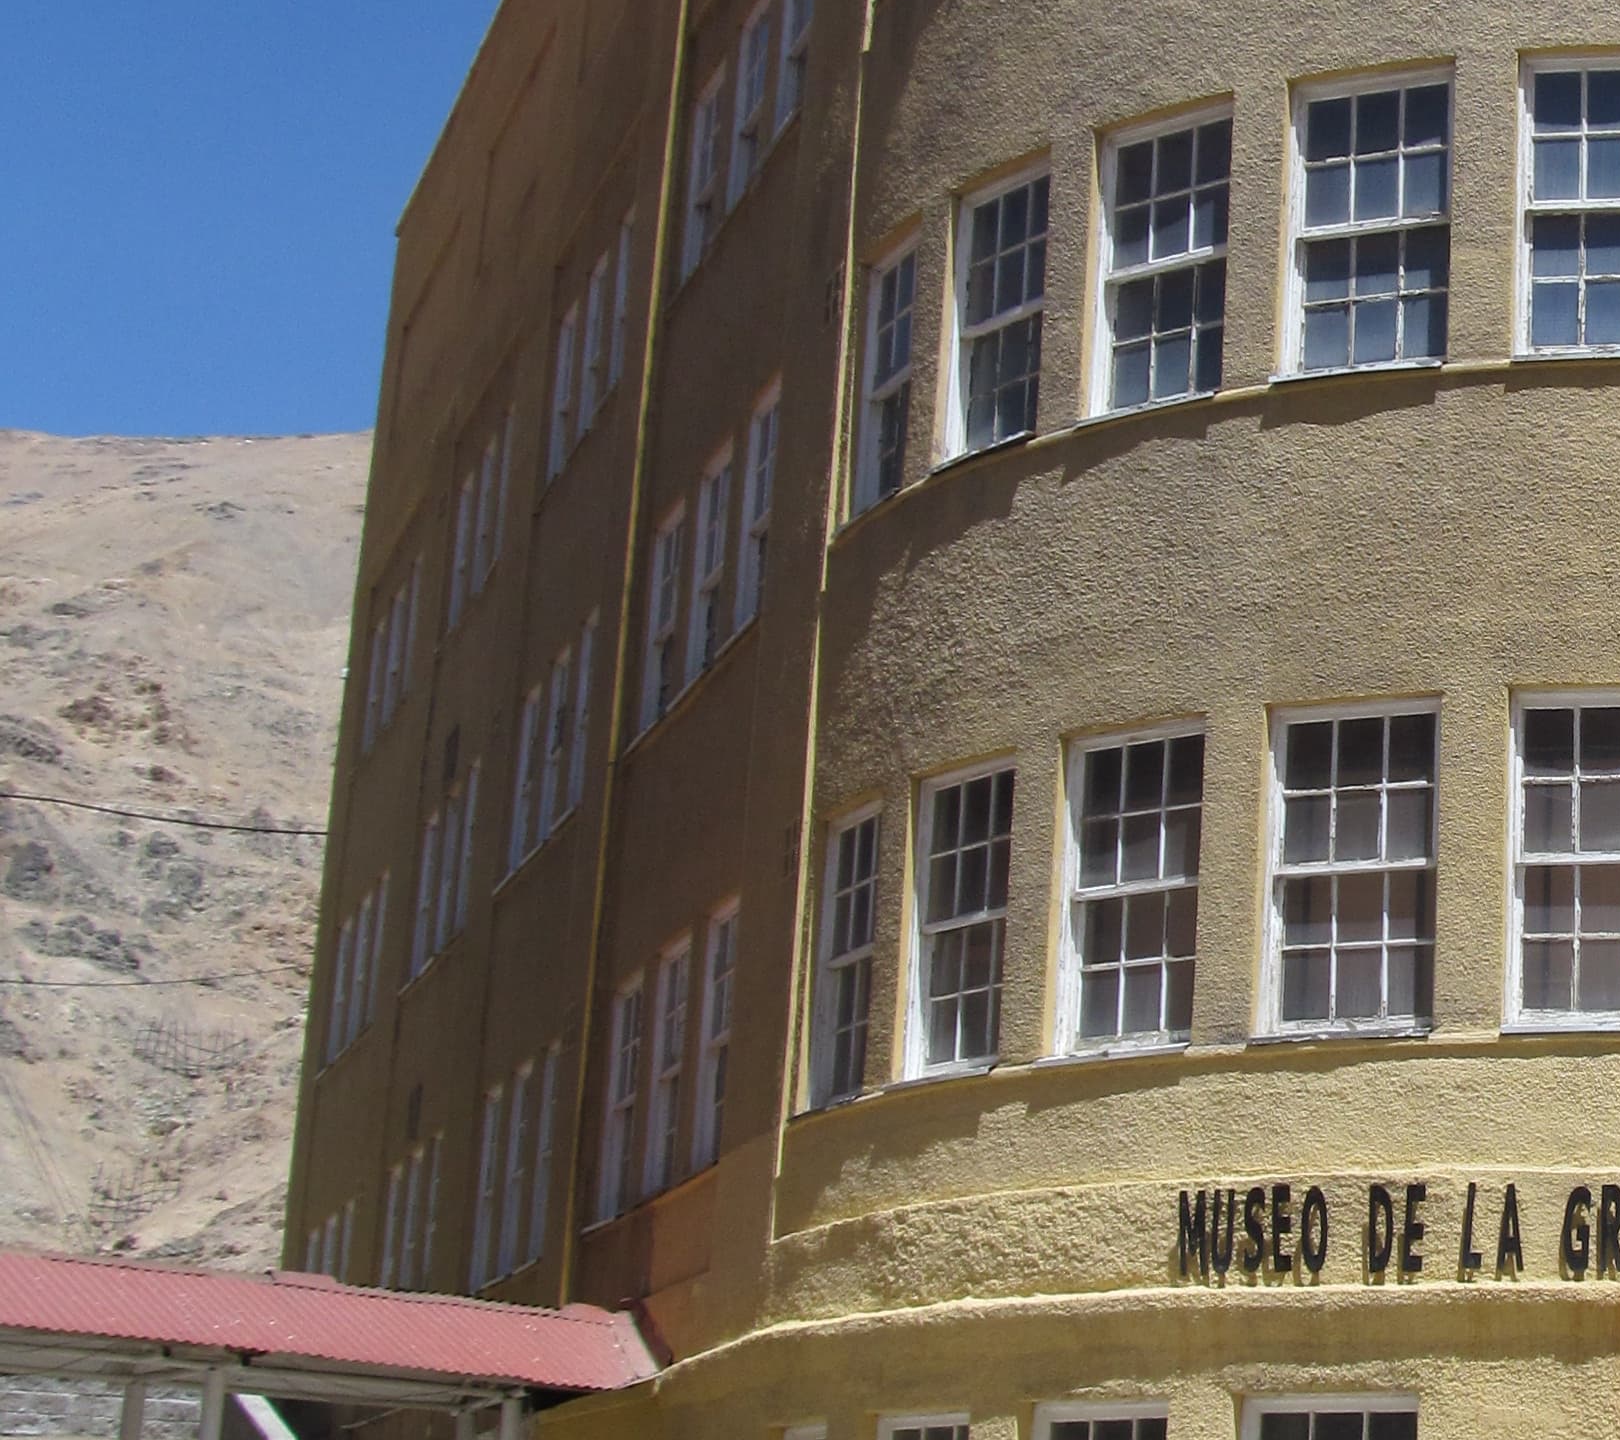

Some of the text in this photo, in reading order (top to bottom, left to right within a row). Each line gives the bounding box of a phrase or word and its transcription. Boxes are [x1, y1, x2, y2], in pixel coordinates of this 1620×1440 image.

[1178, 1183, 1329, 1277] MUSEO
[1369, 1183, 1426, 1273] DE
[1463, 1182, 1524, 1273] LA
